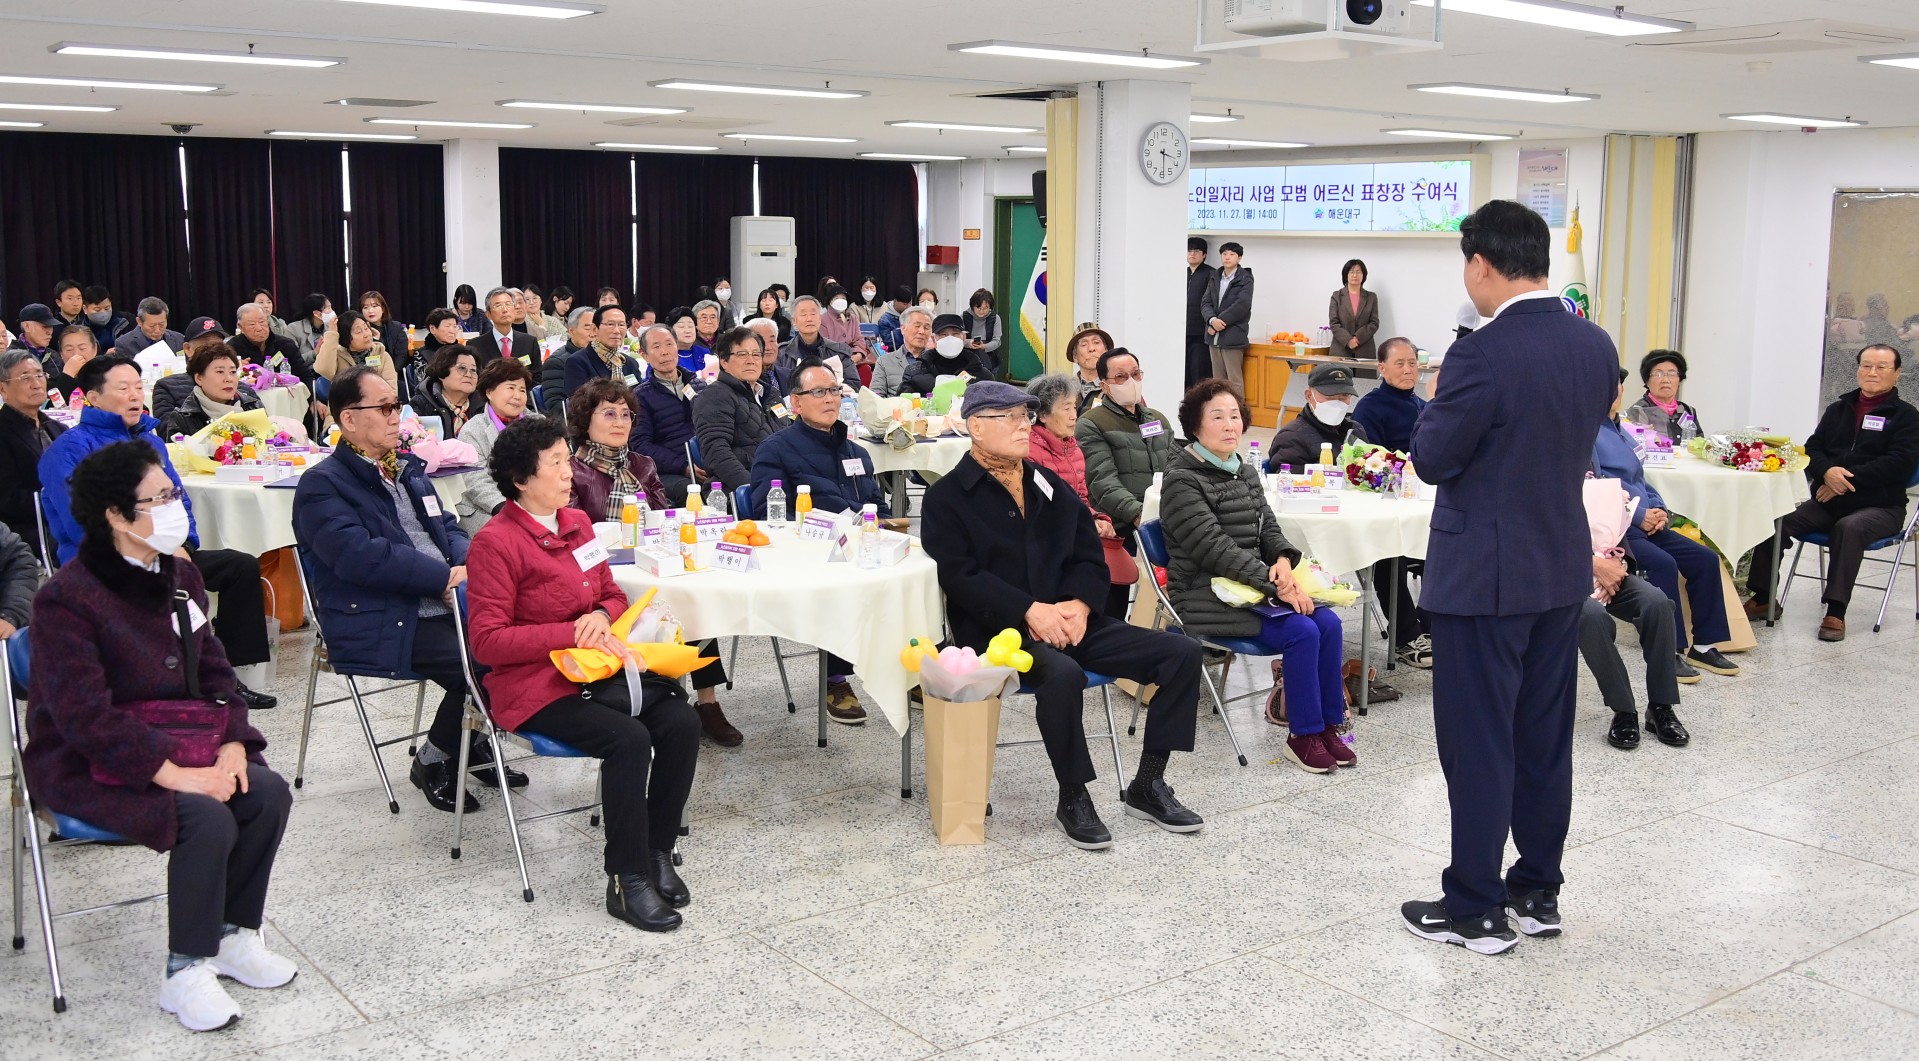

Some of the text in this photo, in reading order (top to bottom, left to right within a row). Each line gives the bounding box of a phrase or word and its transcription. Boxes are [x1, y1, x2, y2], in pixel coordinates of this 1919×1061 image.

[1153, 131, 1159, 140] 11
[1160, 128, 1168, 137] 12
[1147, 138, 1155, 147] 10
[1174, 139, 1180, 147] 2
[1144, 149, 1151, 157] 9
[1176, 150, 1182, 158] 3
[1146, 160, 1153, 169] 8
[1152, 167, 1158, 176] 7
[1167, 167, 1173, 176] 5
[1249, 185, 1275, 203] 사업
[1280, 184, 1307, 203] 모범
[1313, 183, 1355, 203] 어르신
[1360, 182, 1406, 202] 표창장
[1411, 181, 1458, 202] 수여식
[1197, 208, 1216, 219] 2023.
[1218, 208, 1229, 219] 11.
[1230, 208, 1241, 219] 27.
[1258, 208, 1278, 219] 14:00
[1328, 208, 1361, 219] 해운대구
